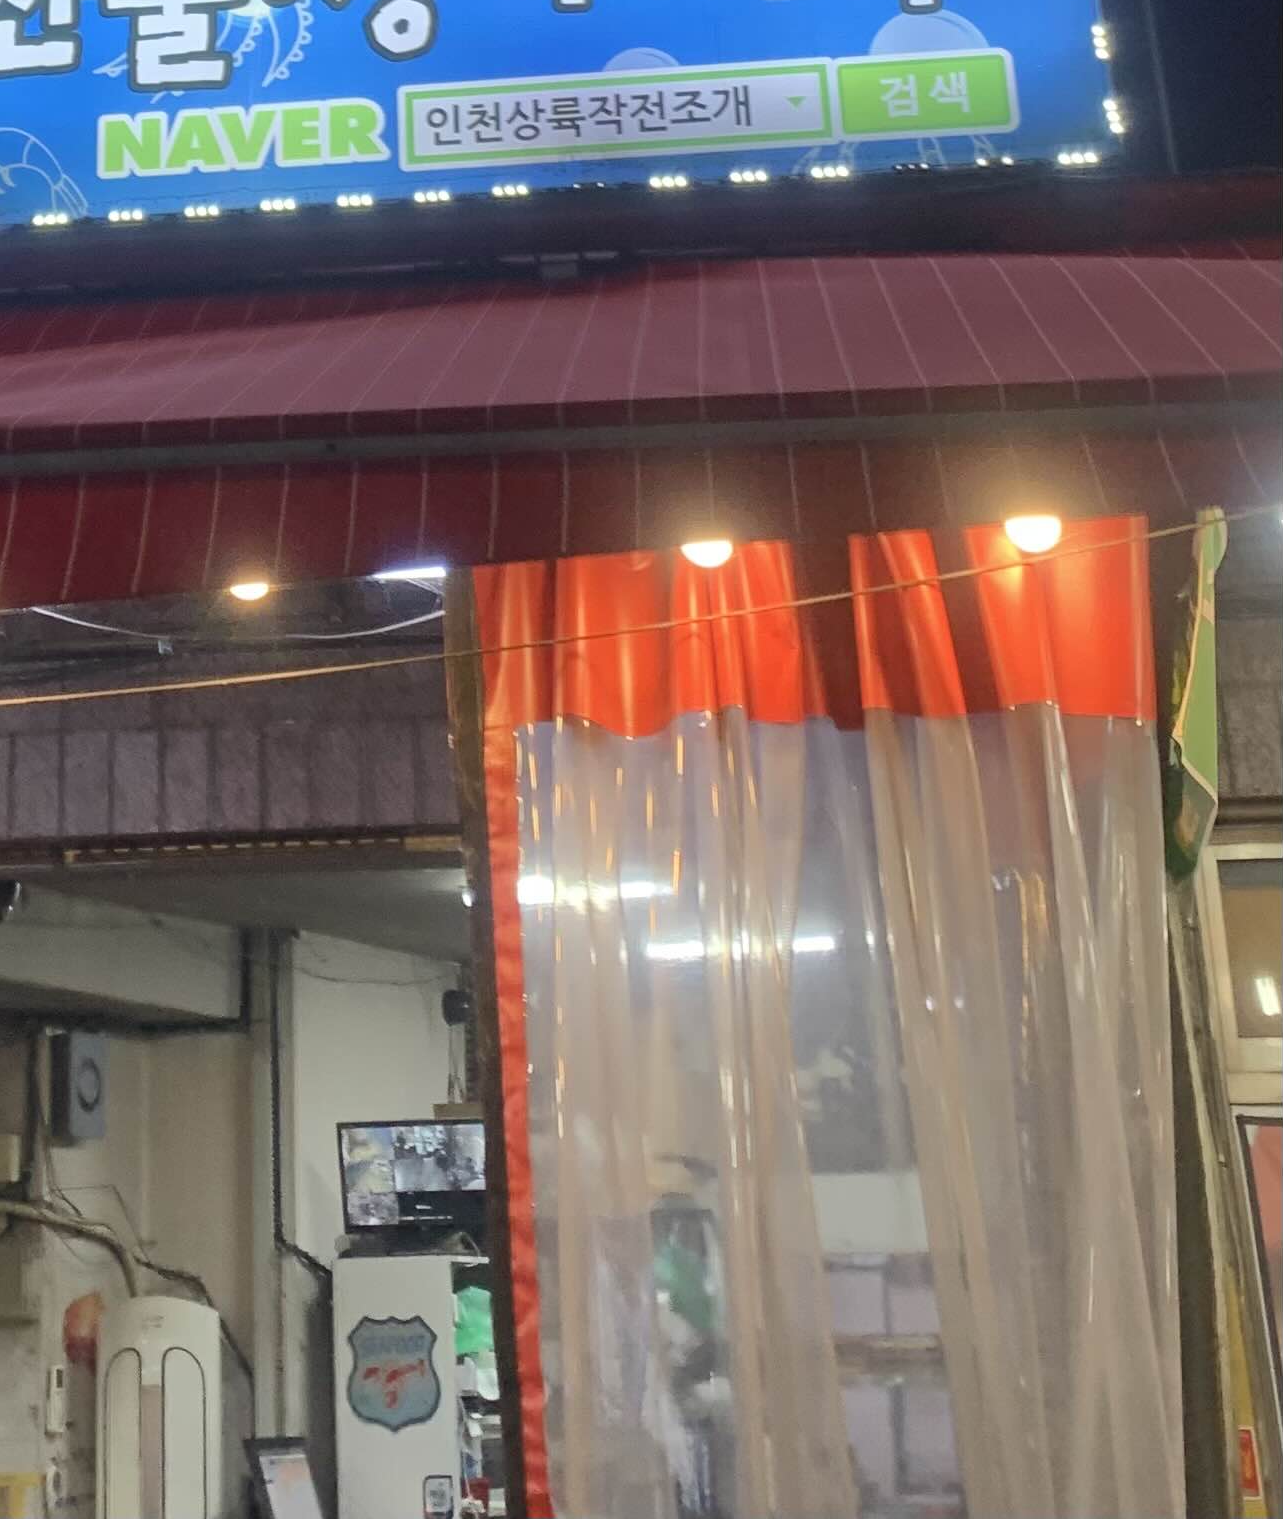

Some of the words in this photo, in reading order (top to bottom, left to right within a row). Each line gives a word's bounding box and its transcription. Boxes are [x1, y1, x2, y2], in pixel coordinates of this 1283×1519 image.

[101, 103, 385, 175] NAVER
[424, 87, 754, 147] 인천상륙작전조개
[878, 66, 972, 121] 검색
